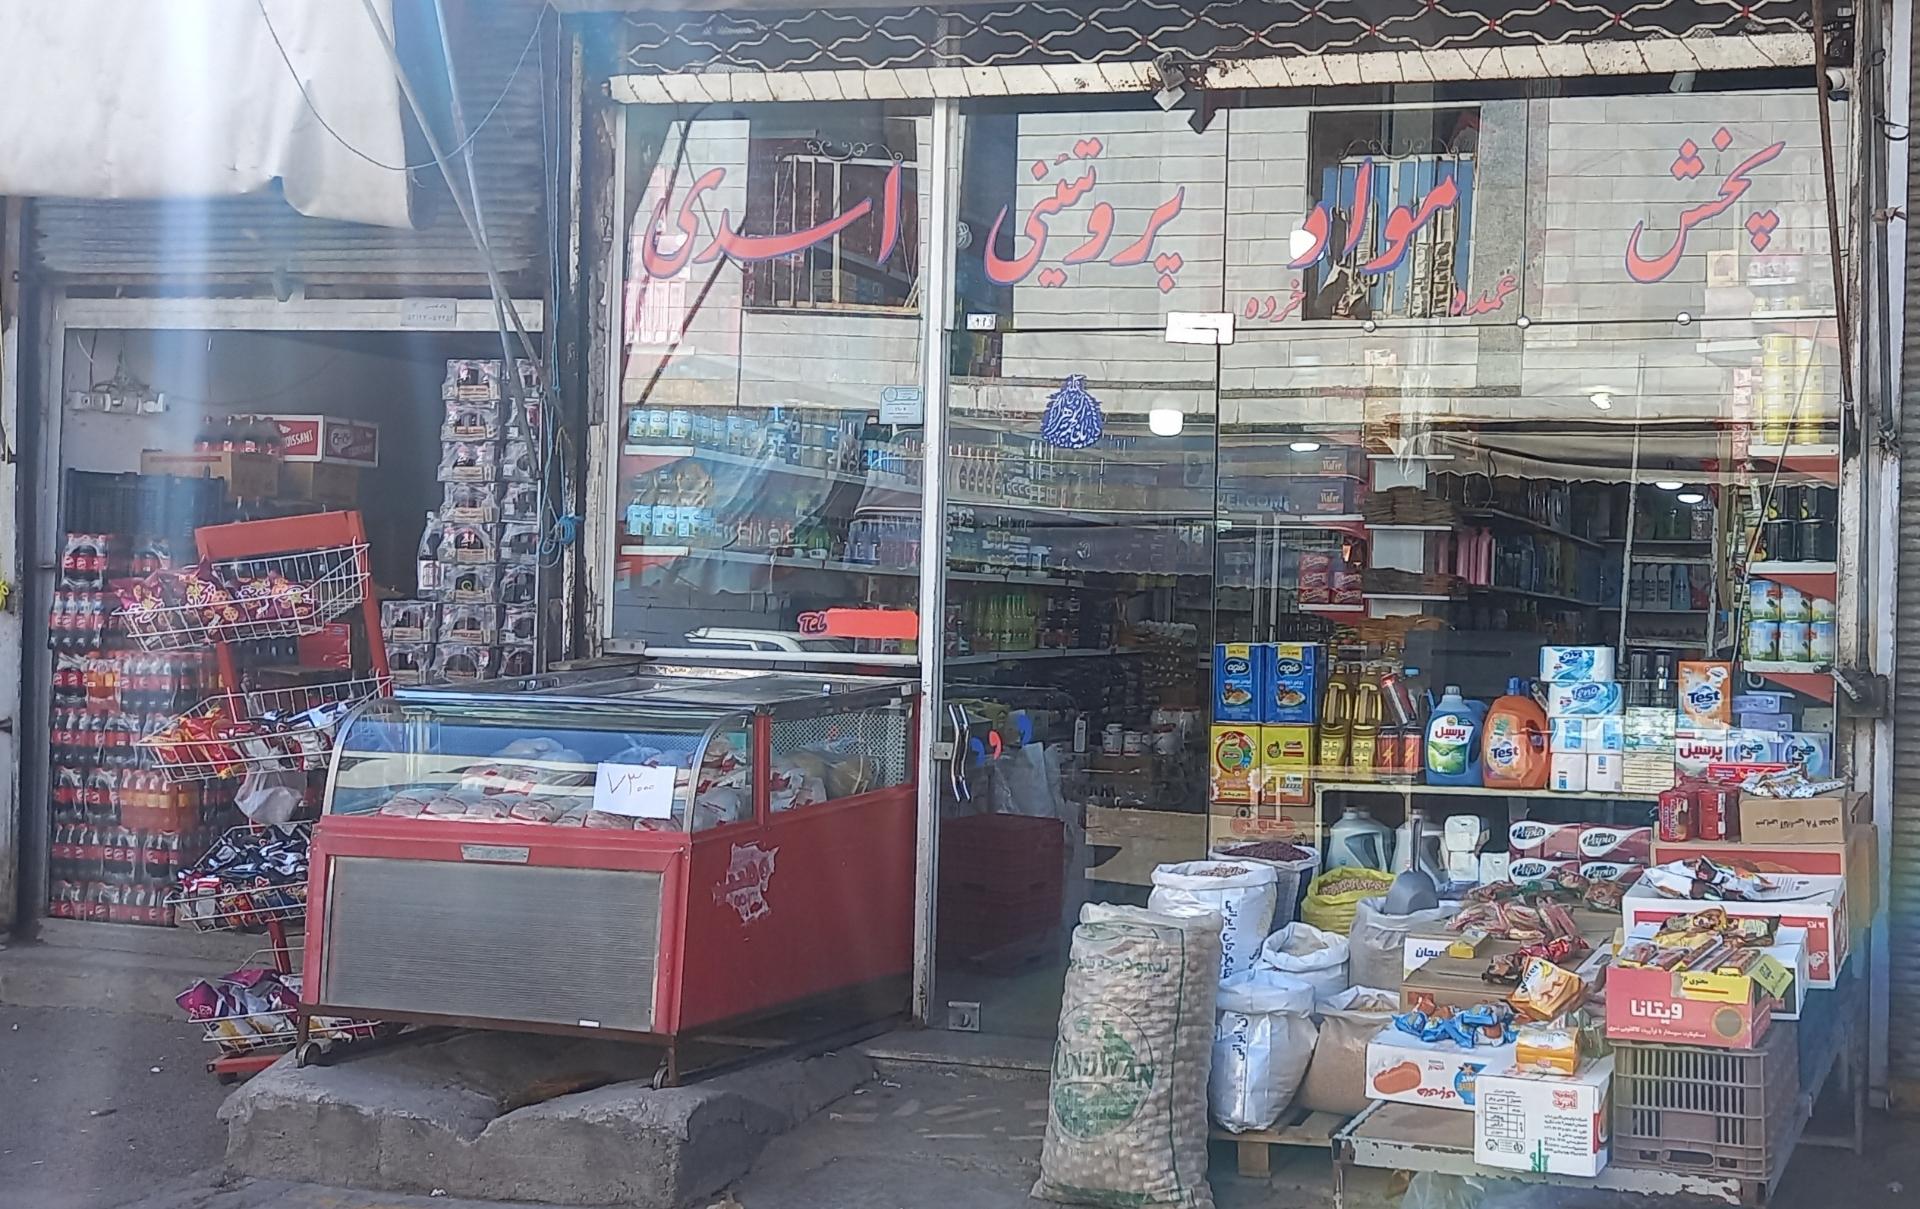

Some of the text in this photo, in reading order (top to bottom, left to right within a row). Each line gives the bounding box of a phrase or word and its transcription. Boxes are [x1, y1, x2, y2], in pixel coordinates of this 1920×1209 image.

[1625, 127, 1786, 283] پخش
[642, 160, 902, 279] اسدی
[1288, 158, 1461, 274] مواد
[1245, 275, 1519, 322] عمده خرده
[285, 429, 314, 448] OISSANT
[800, 613, 828, 633] Tel
[1573, 685, 1599, 699] Teno
[1687, 689, 1721, 703] Test
[1435, 726, 1466, 741] پرسیل
[1490, 746, 1519, 759] Test
[1679, 742, 1723, 762] پرسیل
[1514, 827, 1545, 840] Papia
[1583, 833, 1617, 847] Papia
[1514, 864, 1546, 878] Papia
[1584, 866, 1617, 879] Papia
[1630, 999, 1683, 1024] ویتانا
